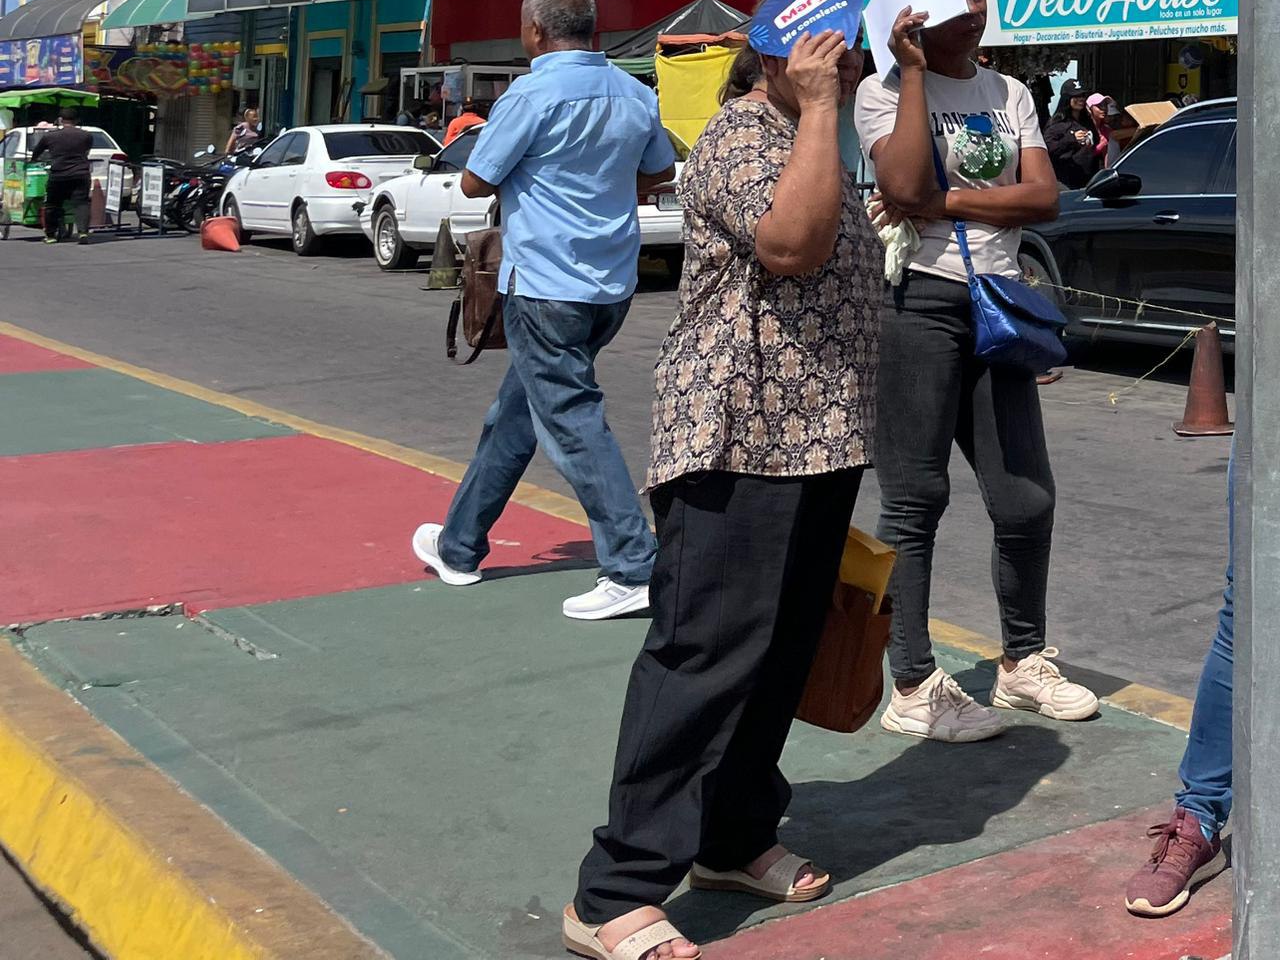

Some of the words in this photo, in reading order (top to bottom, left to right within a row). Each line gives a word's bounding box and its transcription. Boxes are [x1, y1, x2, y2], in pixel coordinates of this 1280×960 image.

[781, 29, 797, 45] Me
[797, 0, 848, 31] consiente
[1013, 33, 1032, 45] Hogar
[1149, 24, 1179, 36] Peluches
[1185, 24, 1208, 34] mucho
[931, 111, 967, 136] LOV
